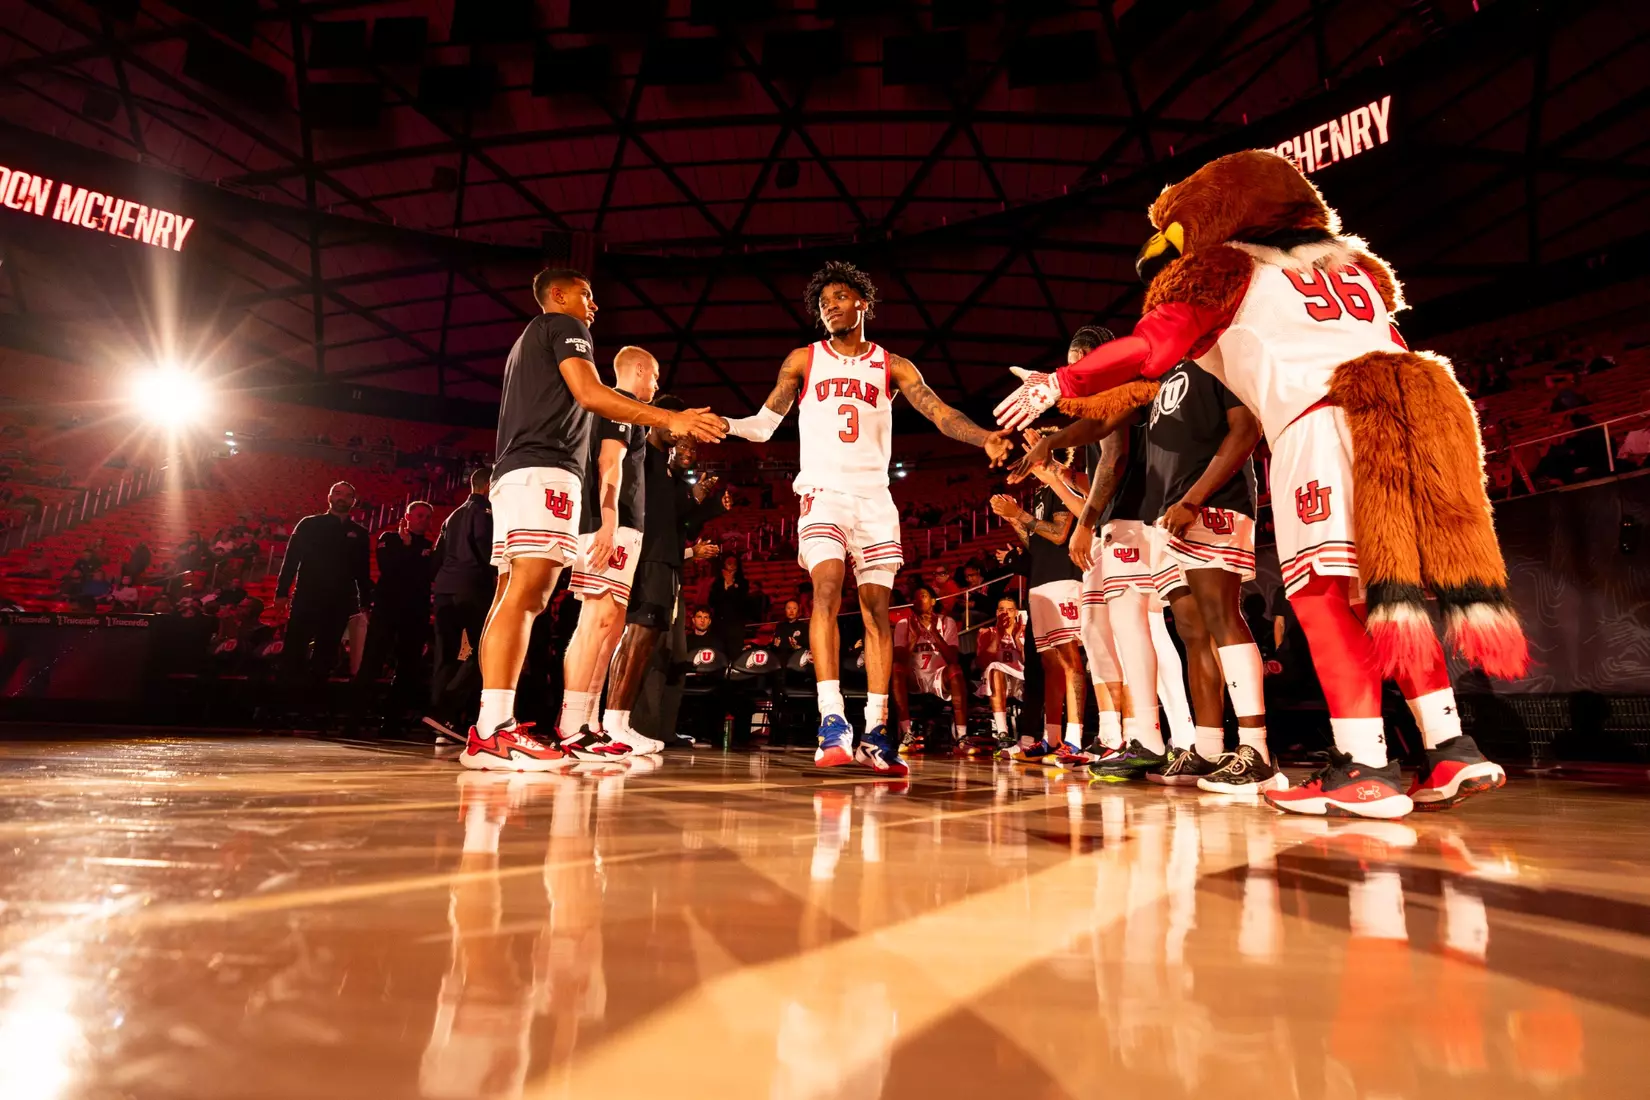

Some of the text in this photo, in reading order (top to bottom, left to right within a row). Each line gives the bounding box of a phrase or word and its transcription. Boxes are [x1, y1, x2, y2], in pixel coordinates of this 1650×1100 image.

[1268, 95, 1391, 174] HENRY
[52, 183, 194, 252] MCHENRY
[1282, 266, 1375, 323] 96
[575, 343, 586, 353] 15
[815, 378, 879, 408] UTAH
[838, 404, 859, 443] 3
[921, 654, 932, 669] 7
